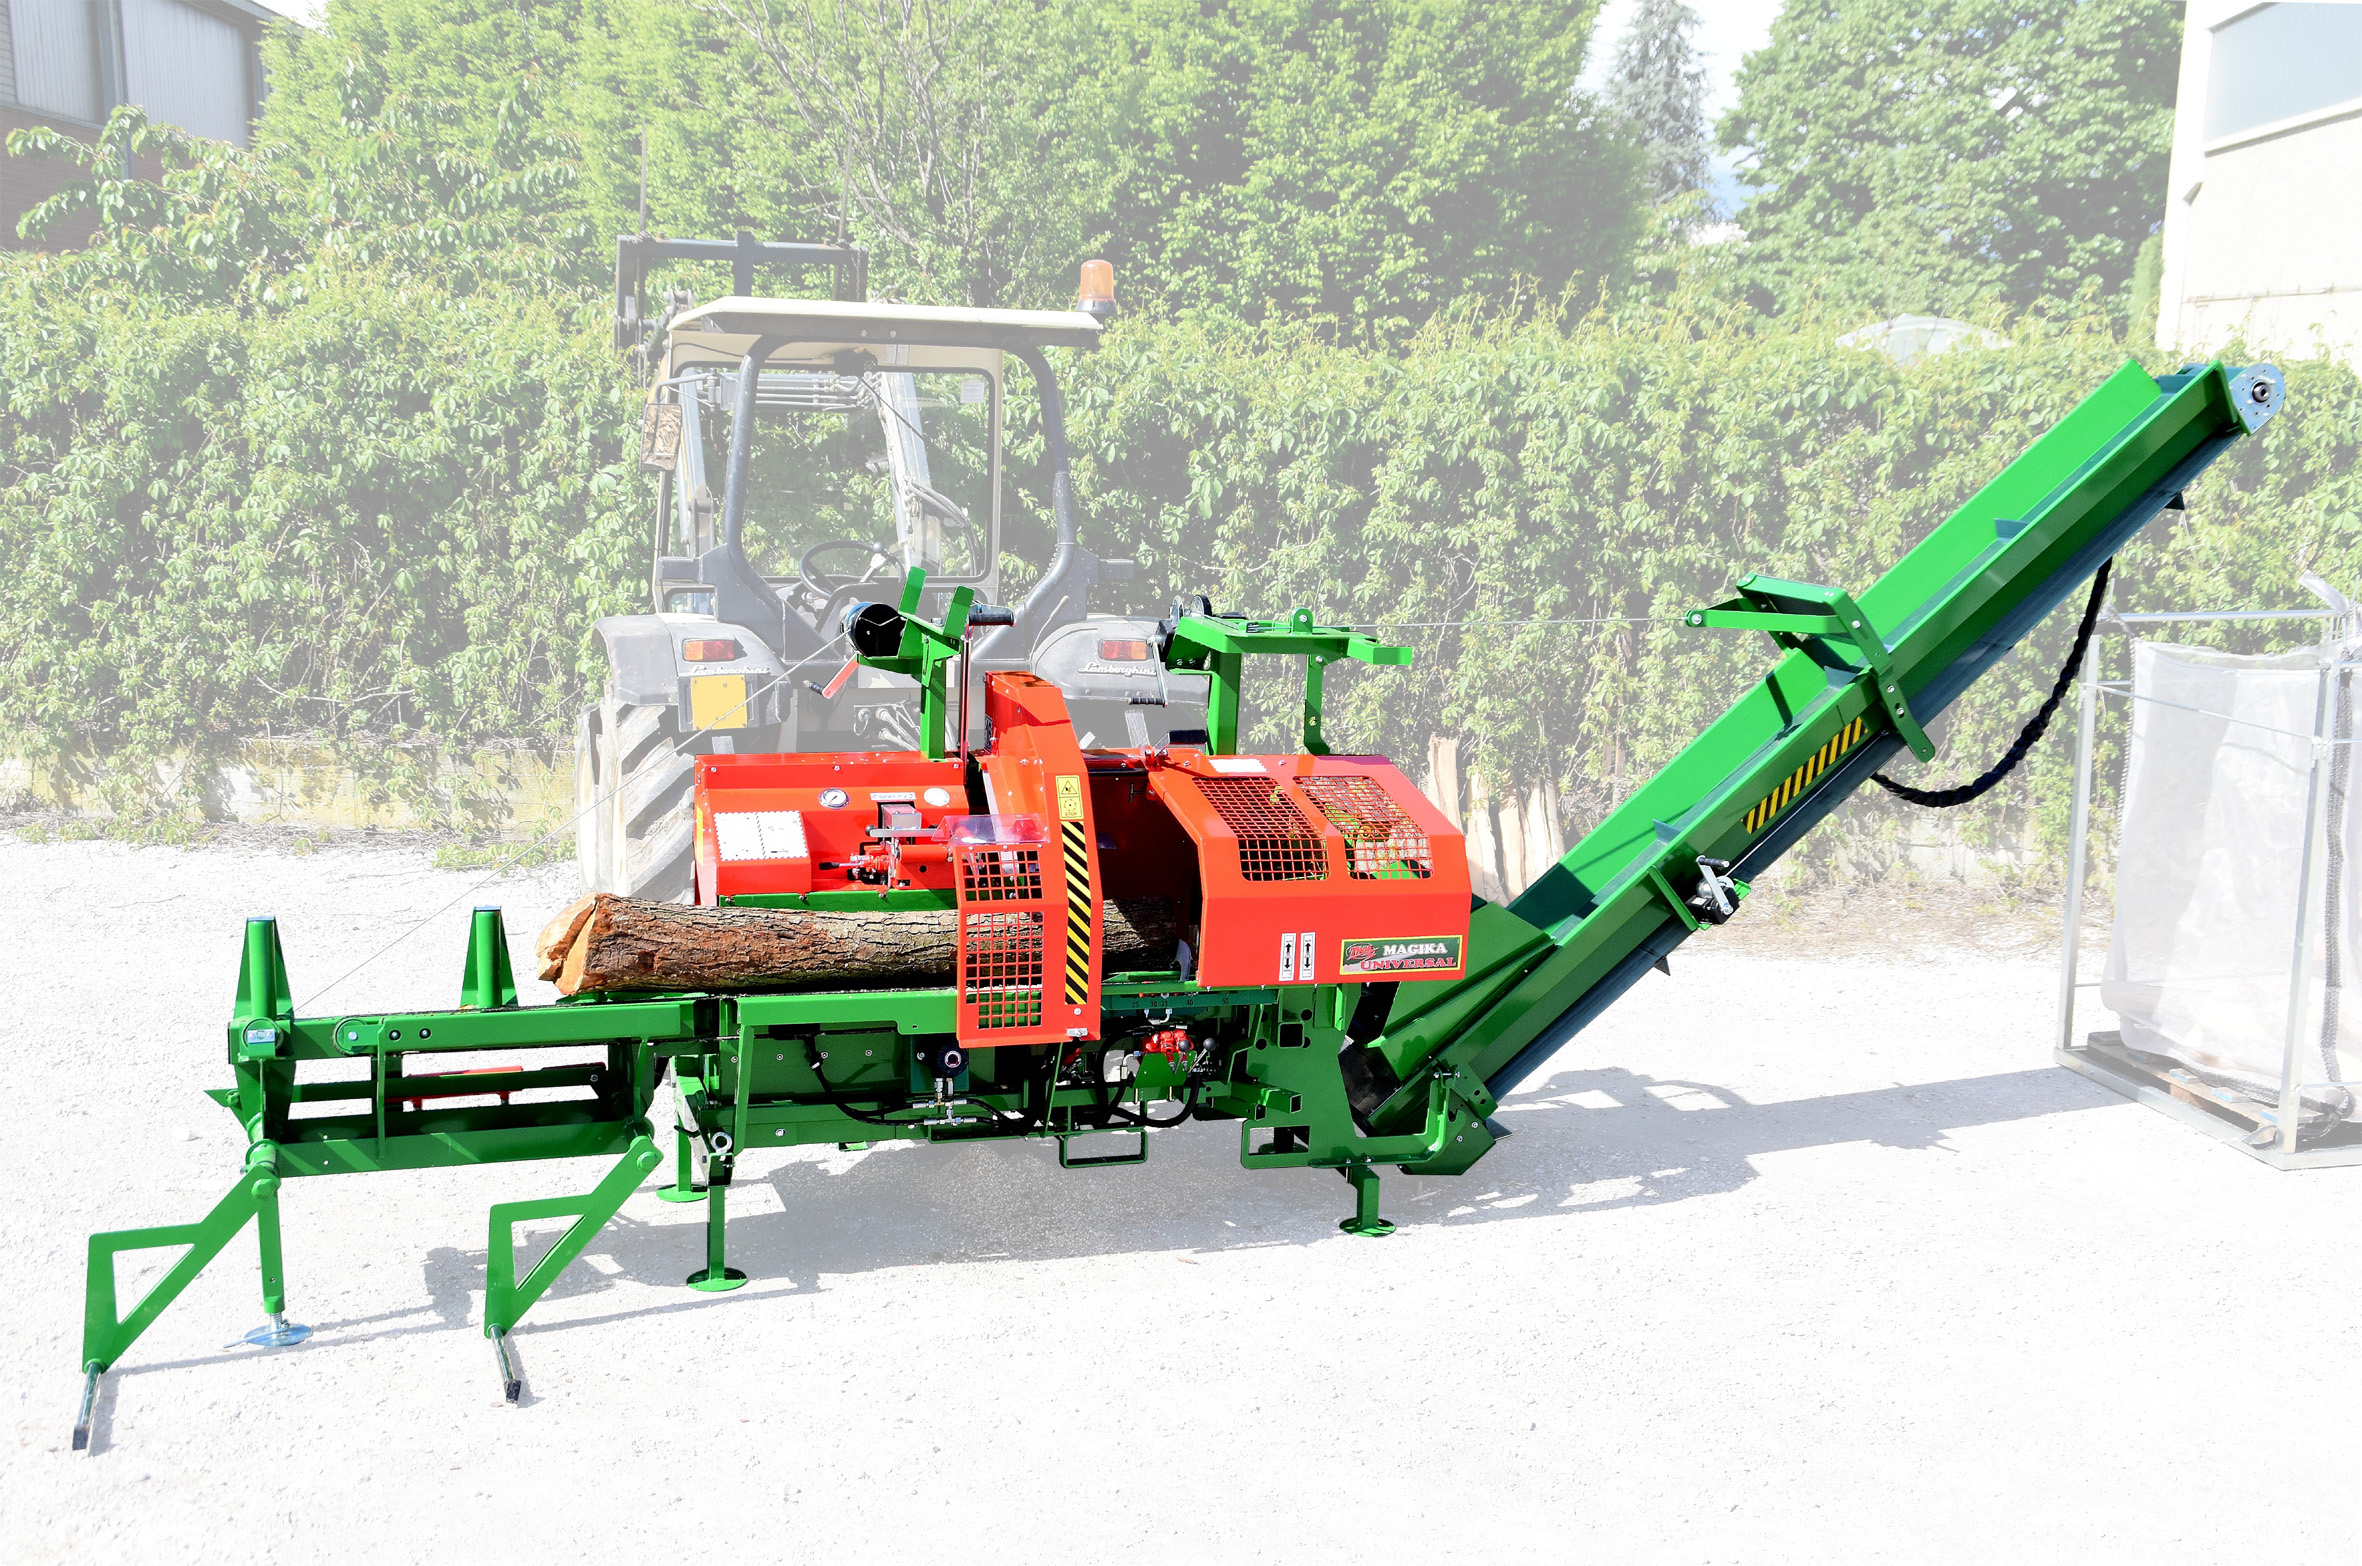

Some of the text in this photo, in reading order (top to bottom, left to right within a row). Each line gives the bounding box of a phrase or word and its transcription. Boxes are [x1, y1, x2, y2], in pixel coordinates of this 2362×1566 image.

[1079, 662, 1157, 678] Lamborghini
[1383, 942, 1448, 956] MAGIKA
[1360, 957, 1457, 970] UNIVERSAL
